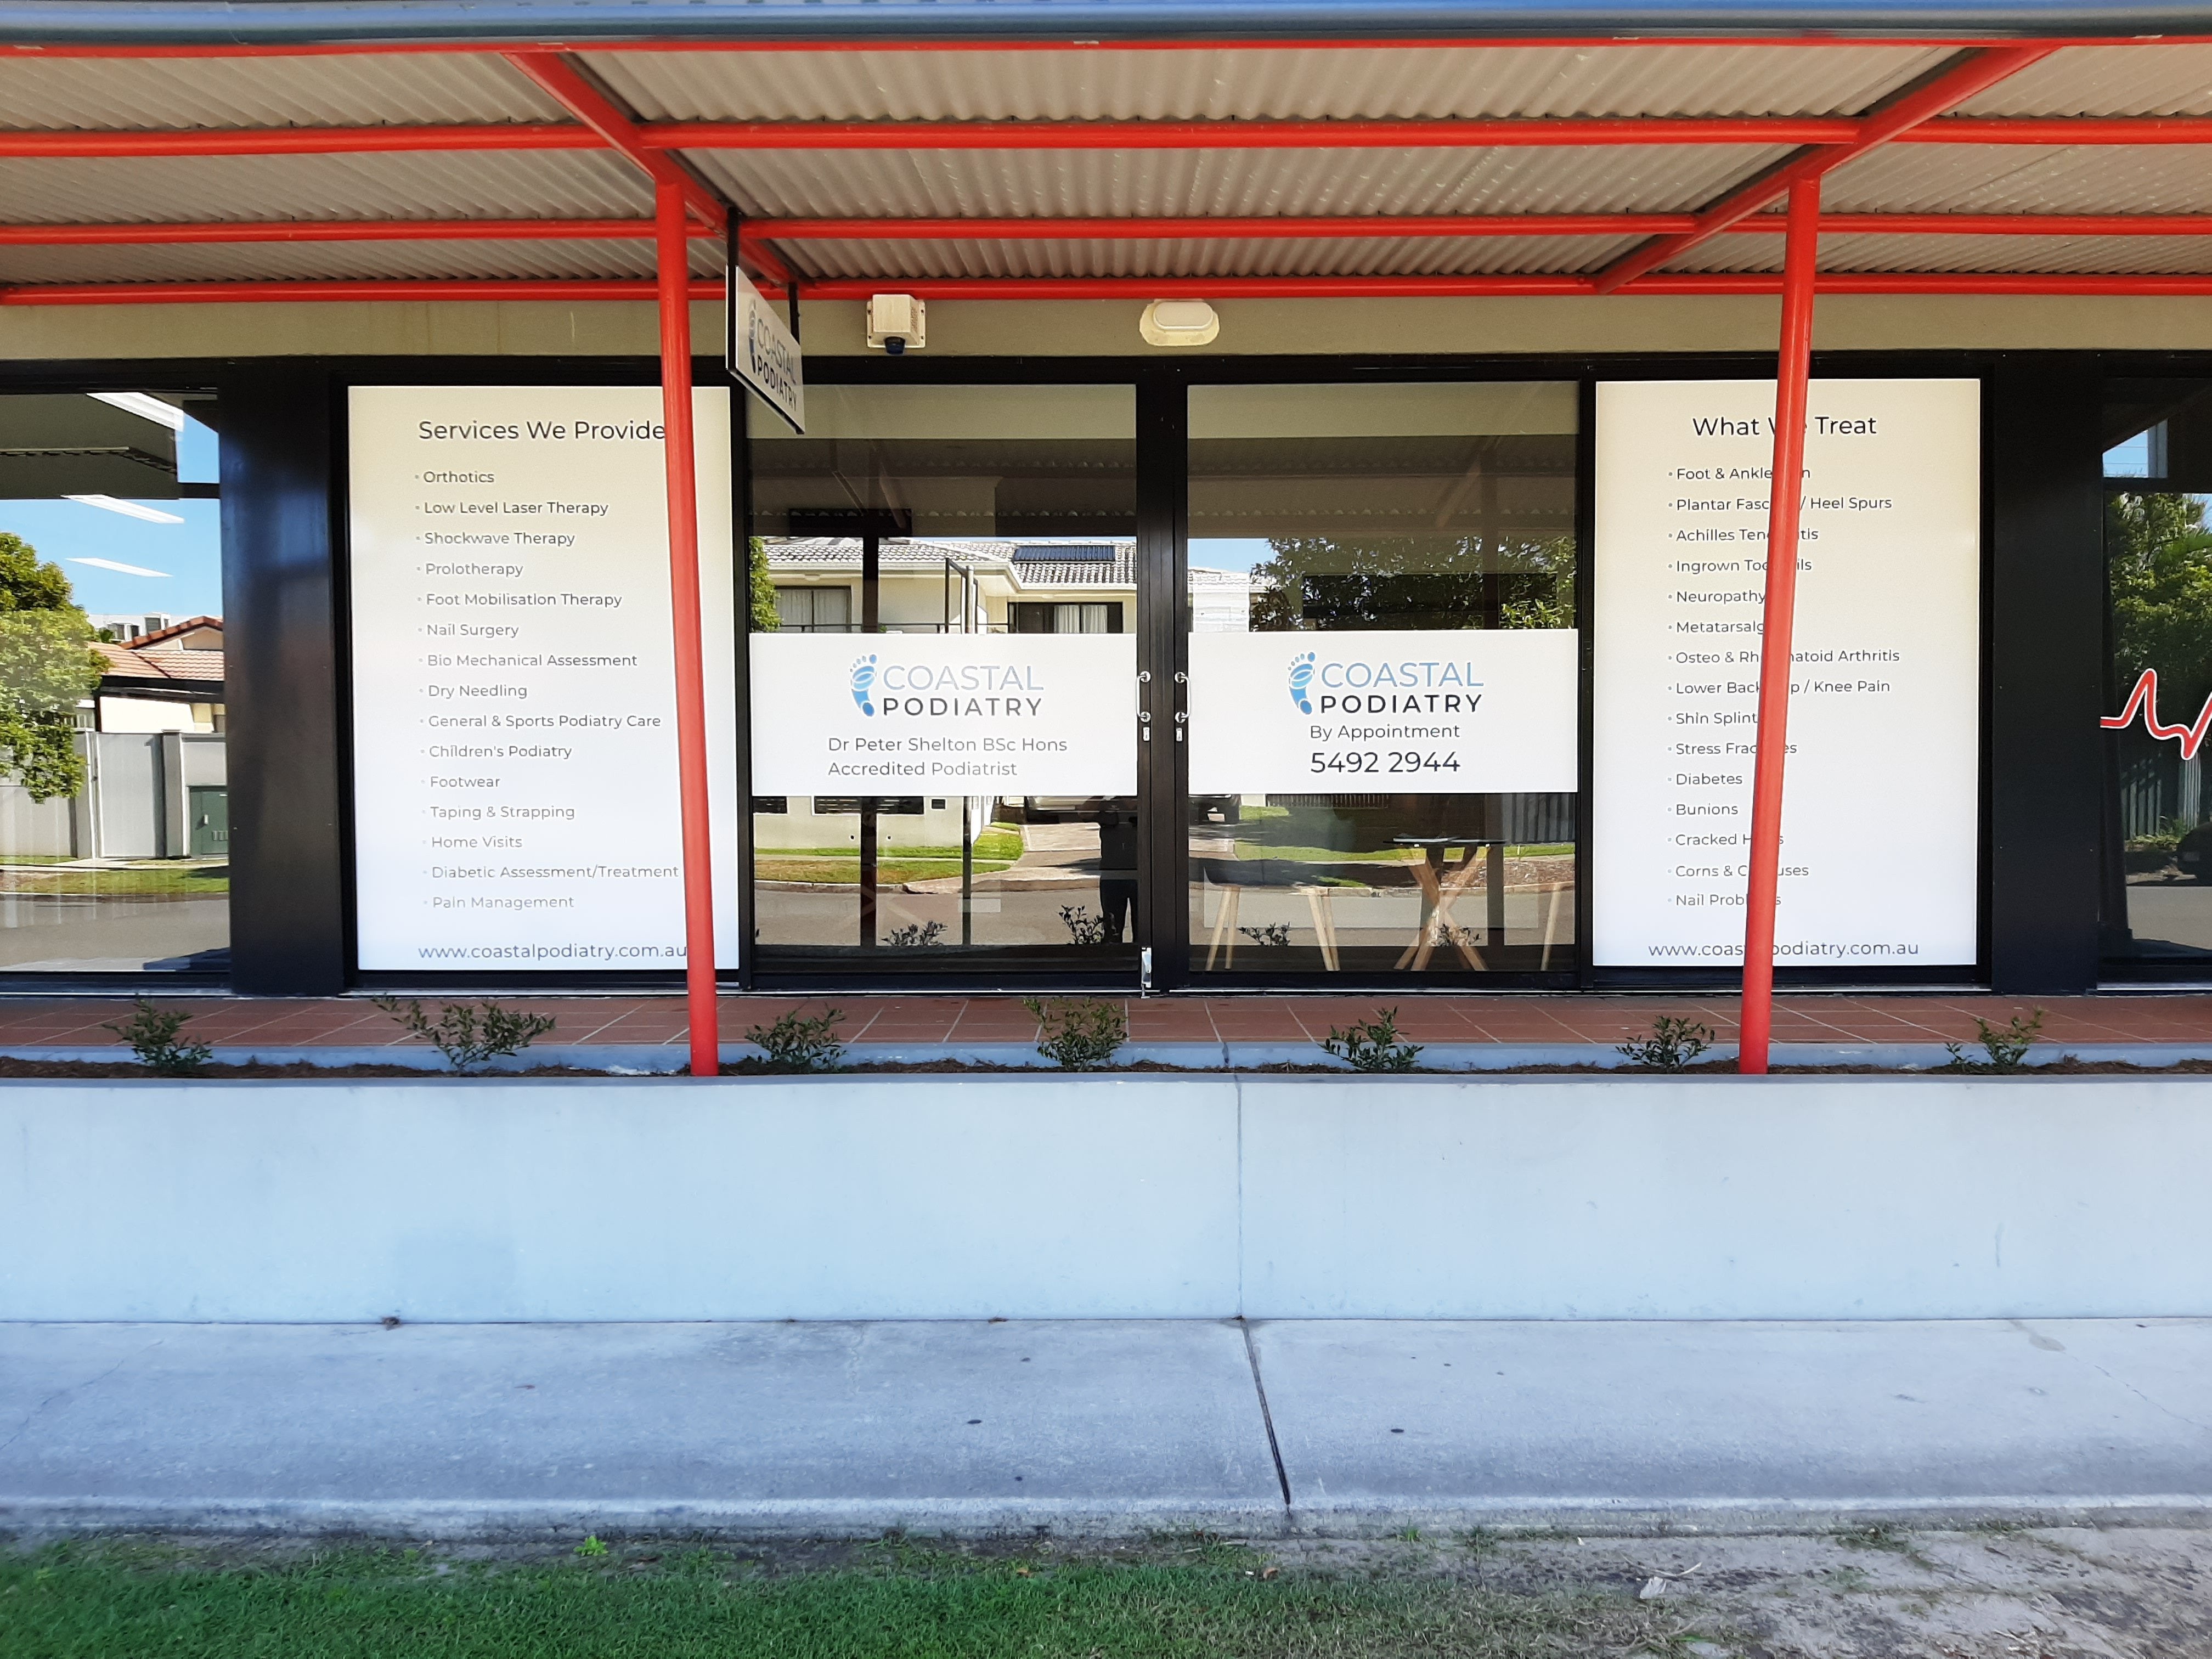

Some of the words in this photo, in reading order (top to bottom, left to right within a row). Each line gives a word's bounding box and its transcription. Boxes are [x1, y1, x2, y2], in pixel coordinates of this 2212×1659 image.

[757, 318, 796, 386] COASTAL
[758, 354, 797, 411] PODIATRY
[419, 420, 519, 439] Services
[527, 421, 566, 439] We
[575, 420, 665, 439] Provide
[1693, 416, 1759, 436] What
[1815, 416, 1876, 435] Treat
[424, 471, 494, 483] Orthotics
[1678, 469, 1711, 479] Foot
[1716, 468, 1724, 479] &
[1730, 467, 1770, 479] Ankle
[425, 503, 455, 513] Low
[460, 502, 498, 513] Level
[504, 502, 542, 513] Laser
[546, 501, 608, 516] Therapy
[1677, 499, 1731, 510] Plantar
[1811, 497, 1843, 509] Heel
[1849, 498, 1892, 511] Spurs
[425, 532, 509, 544] Shockwave
[514, 532, 575, 546] Therapy
[1677, 529, 1735, 541] Achilles
[1739, 528, 1818, 540] Tentis
[426, 563, 523, 577] Prolotherapy
[1677, 561, 1739, 574] Ingrown
[1744, 559, 1812, 571] Toeils
[427, 594, 460, 605] Foot
[465, 594, 556, 605] Mobilisation
[561, 594, 622, 608] Therapy
[1677, 590, 1765, 604] Neuropathy
[427, 624, 455, 635] Nail
[460, 624, 518, 638] Surgery
[1677, 620, 1764, 635] Metatarsalg
[428, 654, 451, 665] Bio
[458, 654, 541, 665] Mechanical
[547, 655, 637, 666] Assessment
[1677, 652, 1720, 663] Osteo
[1725, 652, 1734, 662] &
[1740, 650, 1833, 662] Rhatoid
[1838, 650, 1899, 661] Arthritis
[884, 666, 1043, 690] COASTAL
[1322, 662, 1483, 687] COASTAL
[429, 685, 454, 699] Dry
[460, 685, 527, 699] Needling
[1677, 683, 1722, 693] Lower
[1804, 679, 1810, 693] /
[1815, 681, 1852, 692] Knee
[1858, 680, 1889, 692] Pain
[884, 698, 1041, 716] PODIATRY
[1321, 694, 1481, 713] PODIATRY
[429, 715, 486, 726] General
[492, 716, 501, 726] &
[506, 715, 554, 729] Sports
[560, 715, 622, 729] Podiatry
[627, 715, 661, 726] Care
[1677, 712, 1708, 724] Shin
[1714, 712, 1757, 726] Splint
[1311, 726, 1332, 742] By
[1338, 724, 1460, 742] Appointment
[830, 738, 849, 751] Dr
[856, 738, 901, 751] Peter
[909, 737, 975, 751] Shelton
[984, 738, 1015, 751] BSc
[1023, 738, 1067, 751] Hons
[1677, 743, 1720, 754] Stress
[1726, 743, 1797, 754] Fraces
[430, 745, 504, 757] Children's
[509, 746, 572, 759] Podiatry
[828, 761, 924, 775] Accredited
[933, 761, 1017, 775] Podiatrist
[1311, 752, 1379, 773] 5492
[1388, 752, 1460, 772] 2944
[431, 777, 500, 787] Footwear
[1677, 773, 1742, 785] Diabetes
[430, 806, 481, 820] Taping
[487, 806, 495, 817] &
[501, 806, 574, 820] Strapping
[1677, 803, 1738, 815] Bunions
[432, 837, 477, 848] Home
[483, 836, 522, 847] Visits
[1676, 833, 1736, 845] Cracked
[433, 866, 495, 878] Diabetic
[500, 865, 678, 878] Assessment/Treatment
[1676, 866, 1718, 877] Corns
[1724, 866, 1733, 876] &
[1738, 865, 1808, 876] Cuses
[433, 897, 465, 908] Pain
[472, 897, 574, 910] Management
[1677, 894, 1703, 905] Nail
[1710, 894, 1781, 905] Probs
[419, 944, 686, 961] www.coastalpodiatry.com.au
[1649, 941, 1918, 958] www.coasodiatry.com.au
